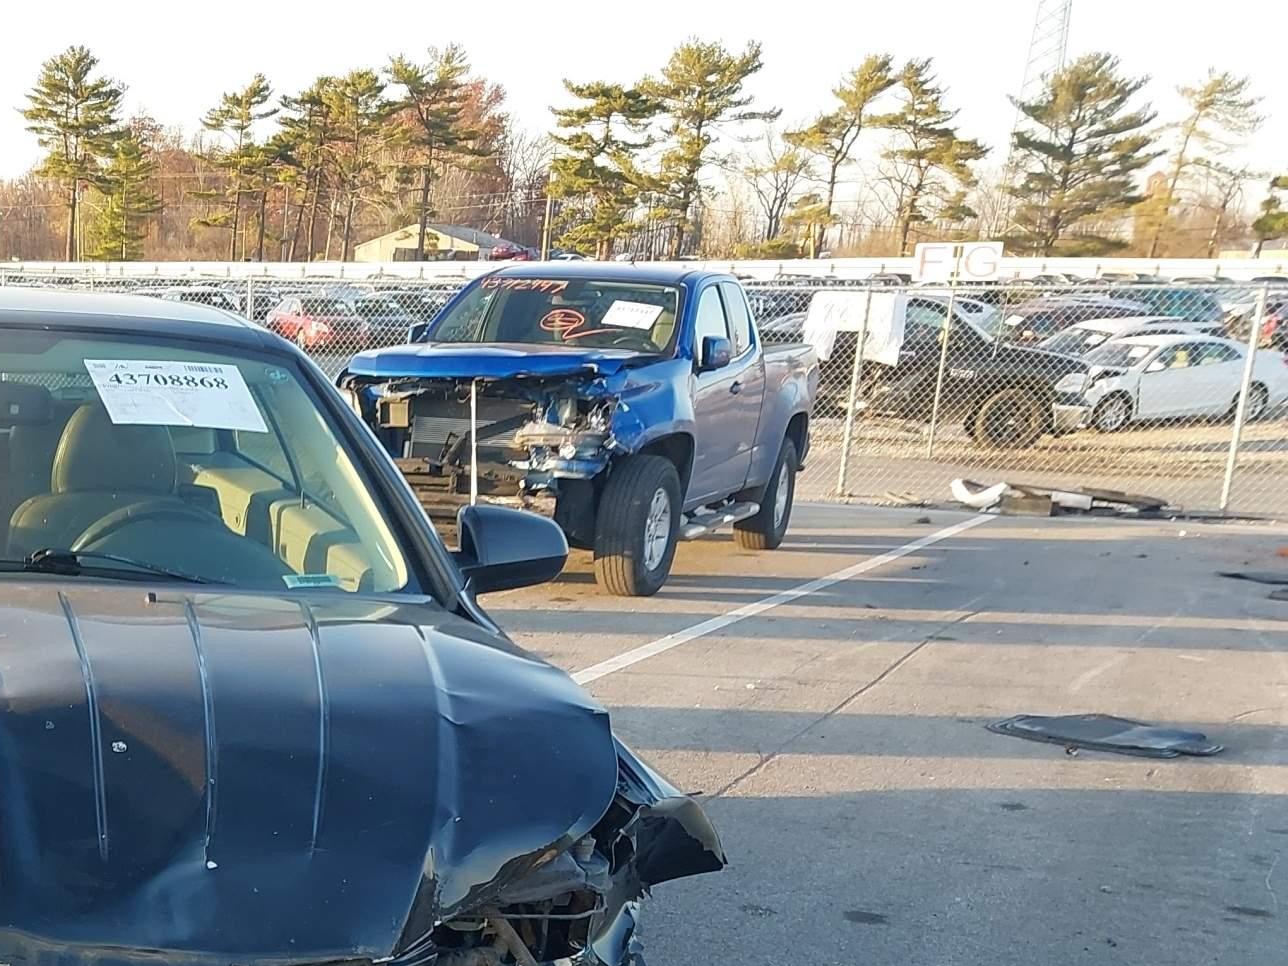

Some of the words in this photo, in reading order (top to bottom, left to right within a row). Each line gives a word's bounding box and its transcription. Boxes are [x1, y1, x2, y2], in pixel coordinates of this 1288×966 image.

[919, 246, 948, 279] F
[964, 245, 998, 278] G
[108, 372, 229, 390] 43708868
